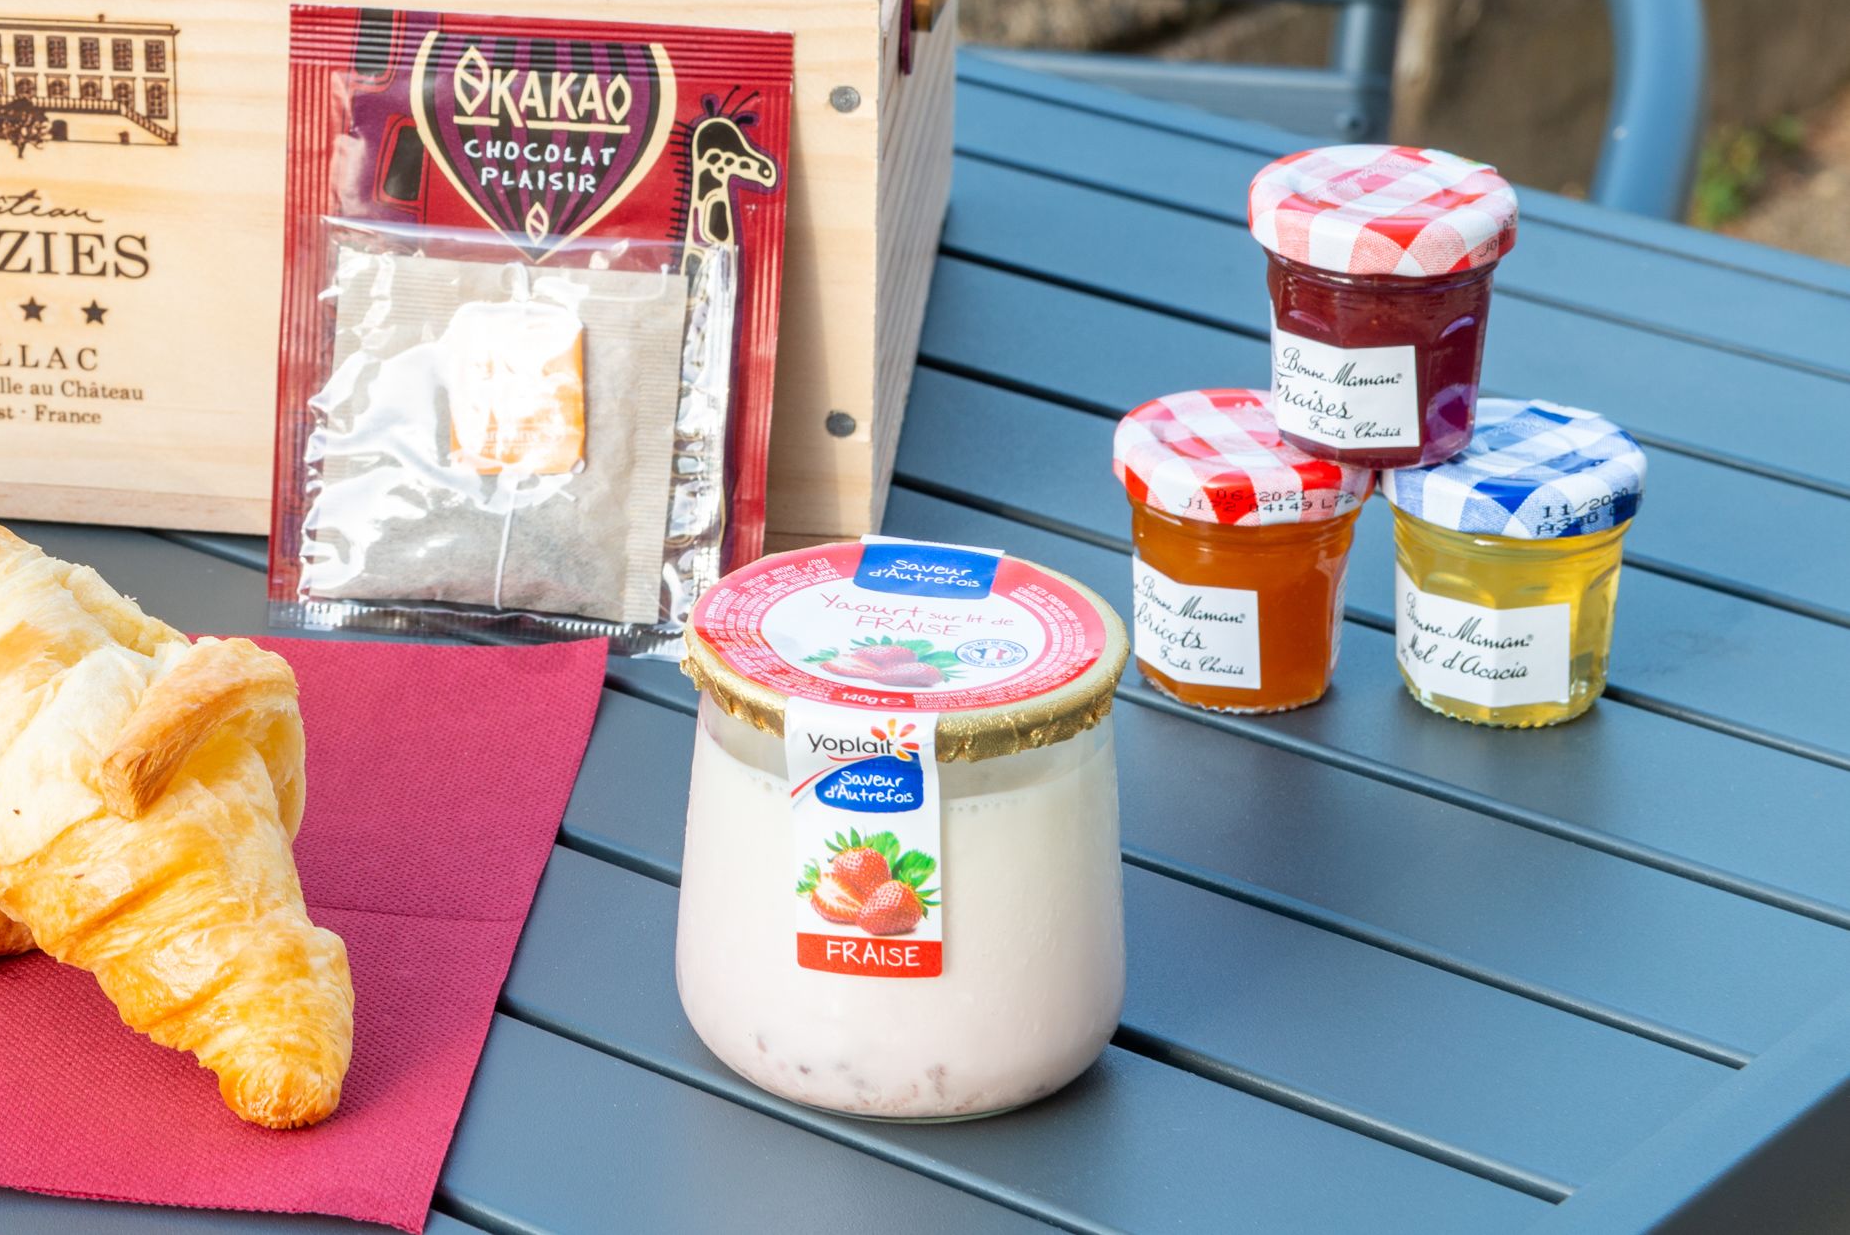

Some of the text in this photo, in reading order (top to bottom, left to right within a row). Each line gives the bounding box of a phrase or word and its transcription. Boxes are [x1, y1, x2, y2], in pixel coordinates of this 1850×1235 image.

[464, 139, 616, 166] CHOCOLAT
[481, 167, 596, 193] PLAISIR
[1283, 347, 1326, 381] Bonne
[29, 382, 54, 397] au
[61, 380, 144, 401] Château
[35, 404, 101, 424] France
[1353, 422, 1402, 439] Choisis
[868, 567, 981, 589] d'Autrefois
[891, 559, 973, 577] Saveur
[820, 593, 924, 618] Yaourt
[855, 615, 963, 637] FRAISE
[1198, 655, 1244, 675] Choisis
[1442, 650, 1529, 680] d'Acacia
[841, 692, 879, 705] 140g
[807, 733, 894, 755] Yoplait
[839, 770, 904, 788] Saveur
[824, 783, 915, 804] d'Autrefois
[826, 940, 921, 968] FRAISE
